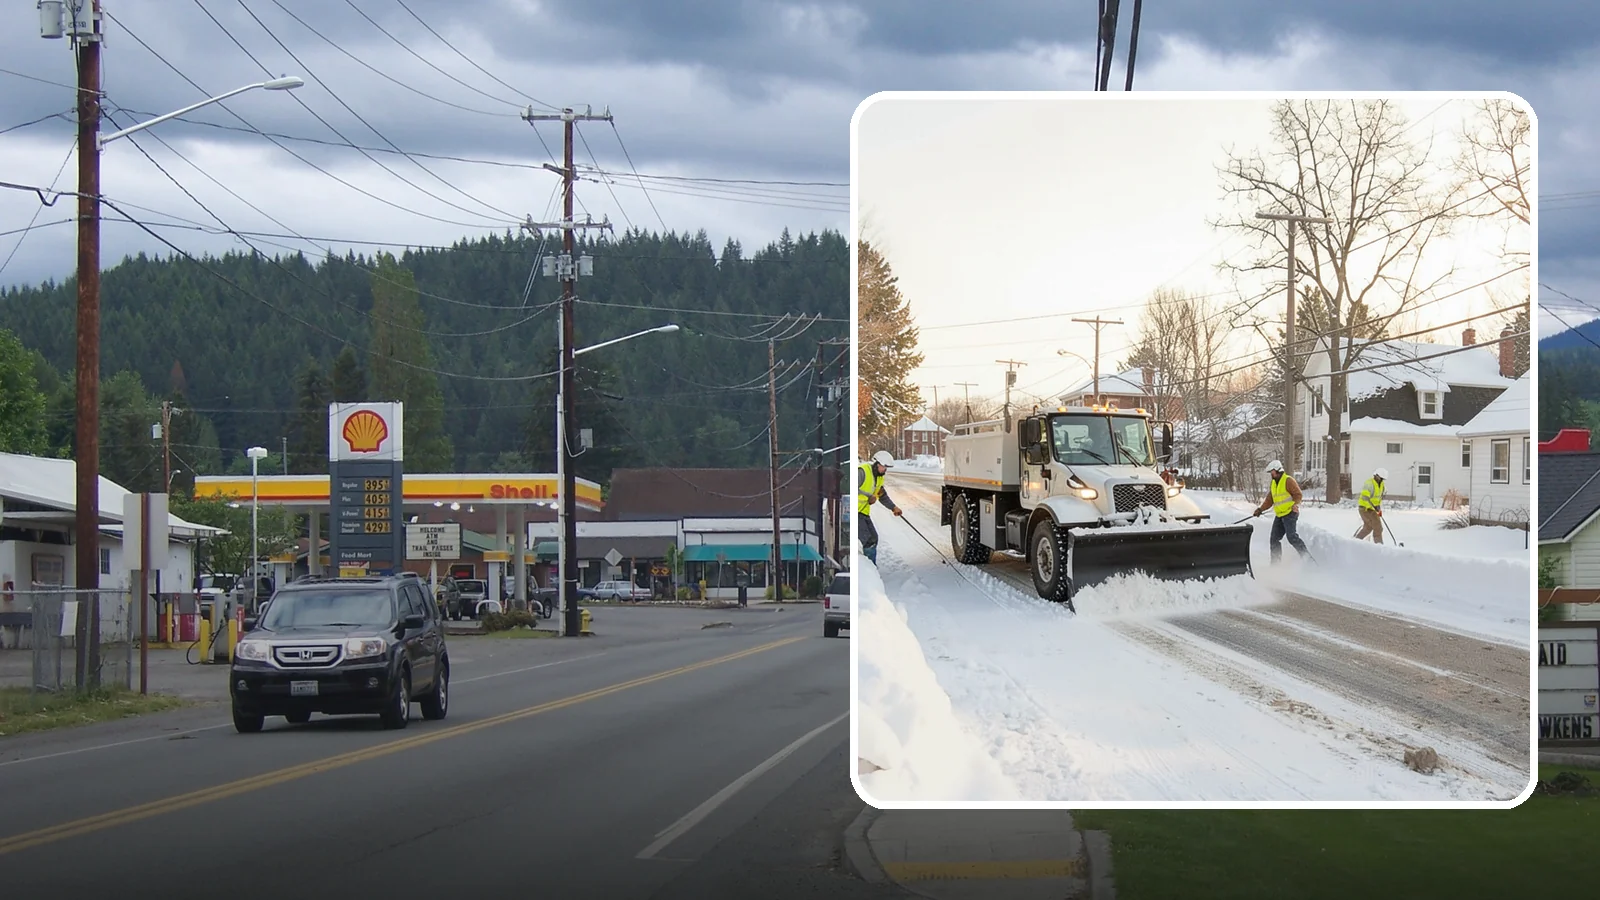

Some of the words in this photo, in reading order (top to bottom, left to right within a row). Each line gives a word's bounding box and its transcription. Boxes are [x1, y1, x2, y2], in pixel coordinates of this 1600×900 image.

[365, 480, 383, 490] 395
[490, 484, 547, 499] Shell
[365, 494, 383, 504] 405
[365, 508, 383, 518] 415
[365, 522, 383, 533] 429
